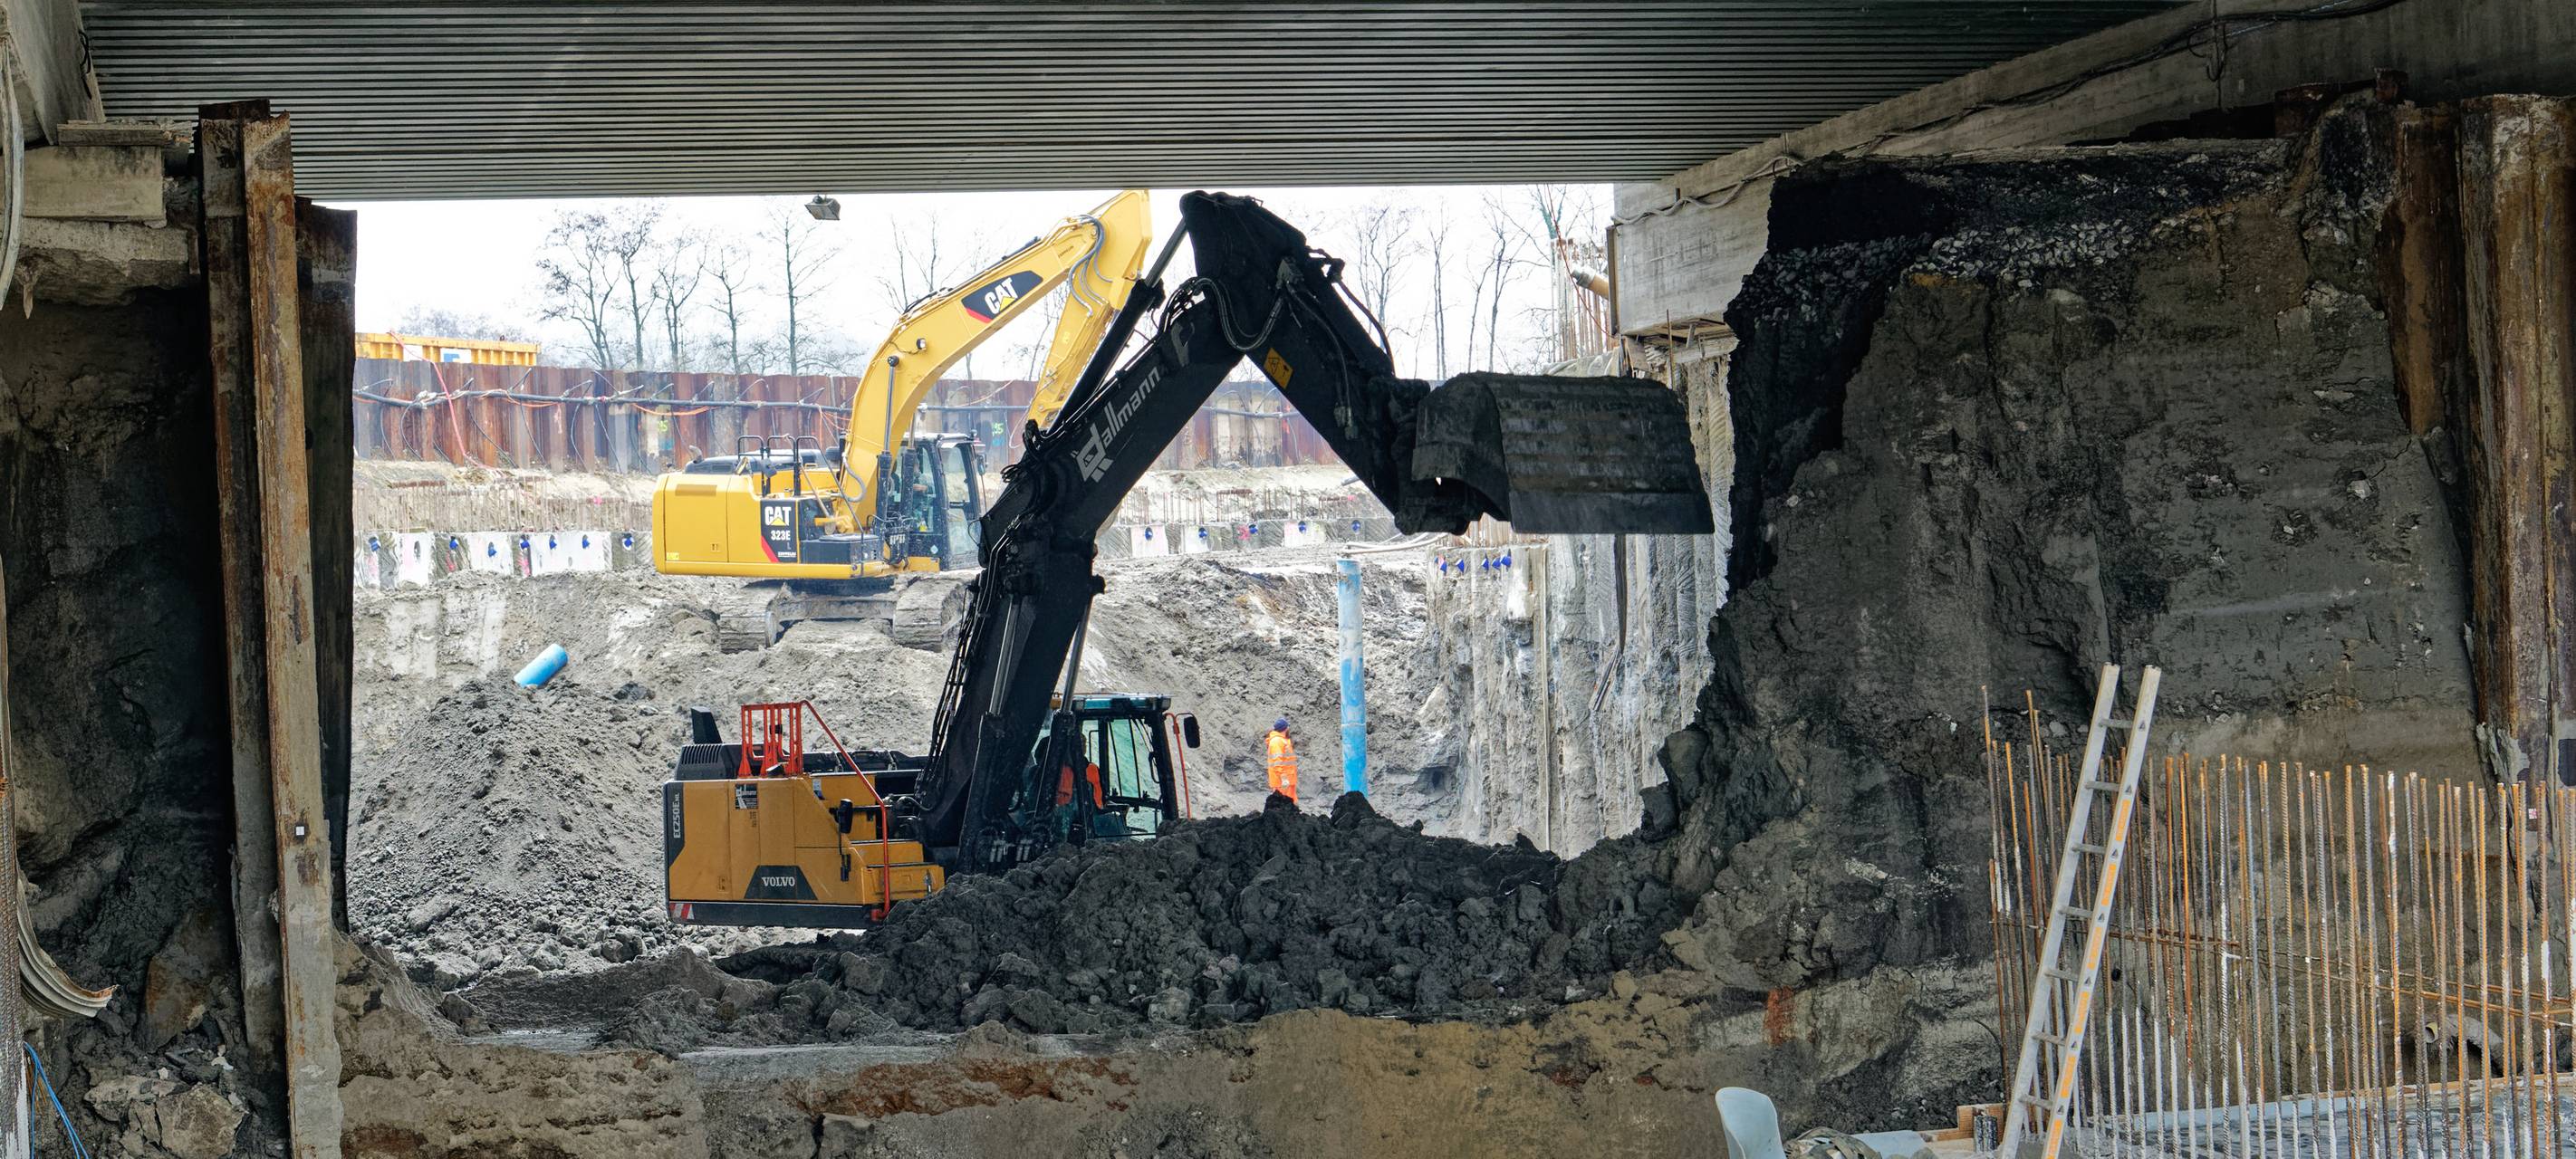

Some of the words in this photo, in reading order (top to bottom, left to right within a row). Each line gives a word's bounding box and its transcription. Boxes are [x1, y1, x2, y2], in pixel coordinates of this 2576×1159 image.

[985, 277, 1018, 314] CAT
[764, 506, 792, 526] CAT
[771, 530, 791, 541] 323E
[761, 876, 795, 886] VOLVO
